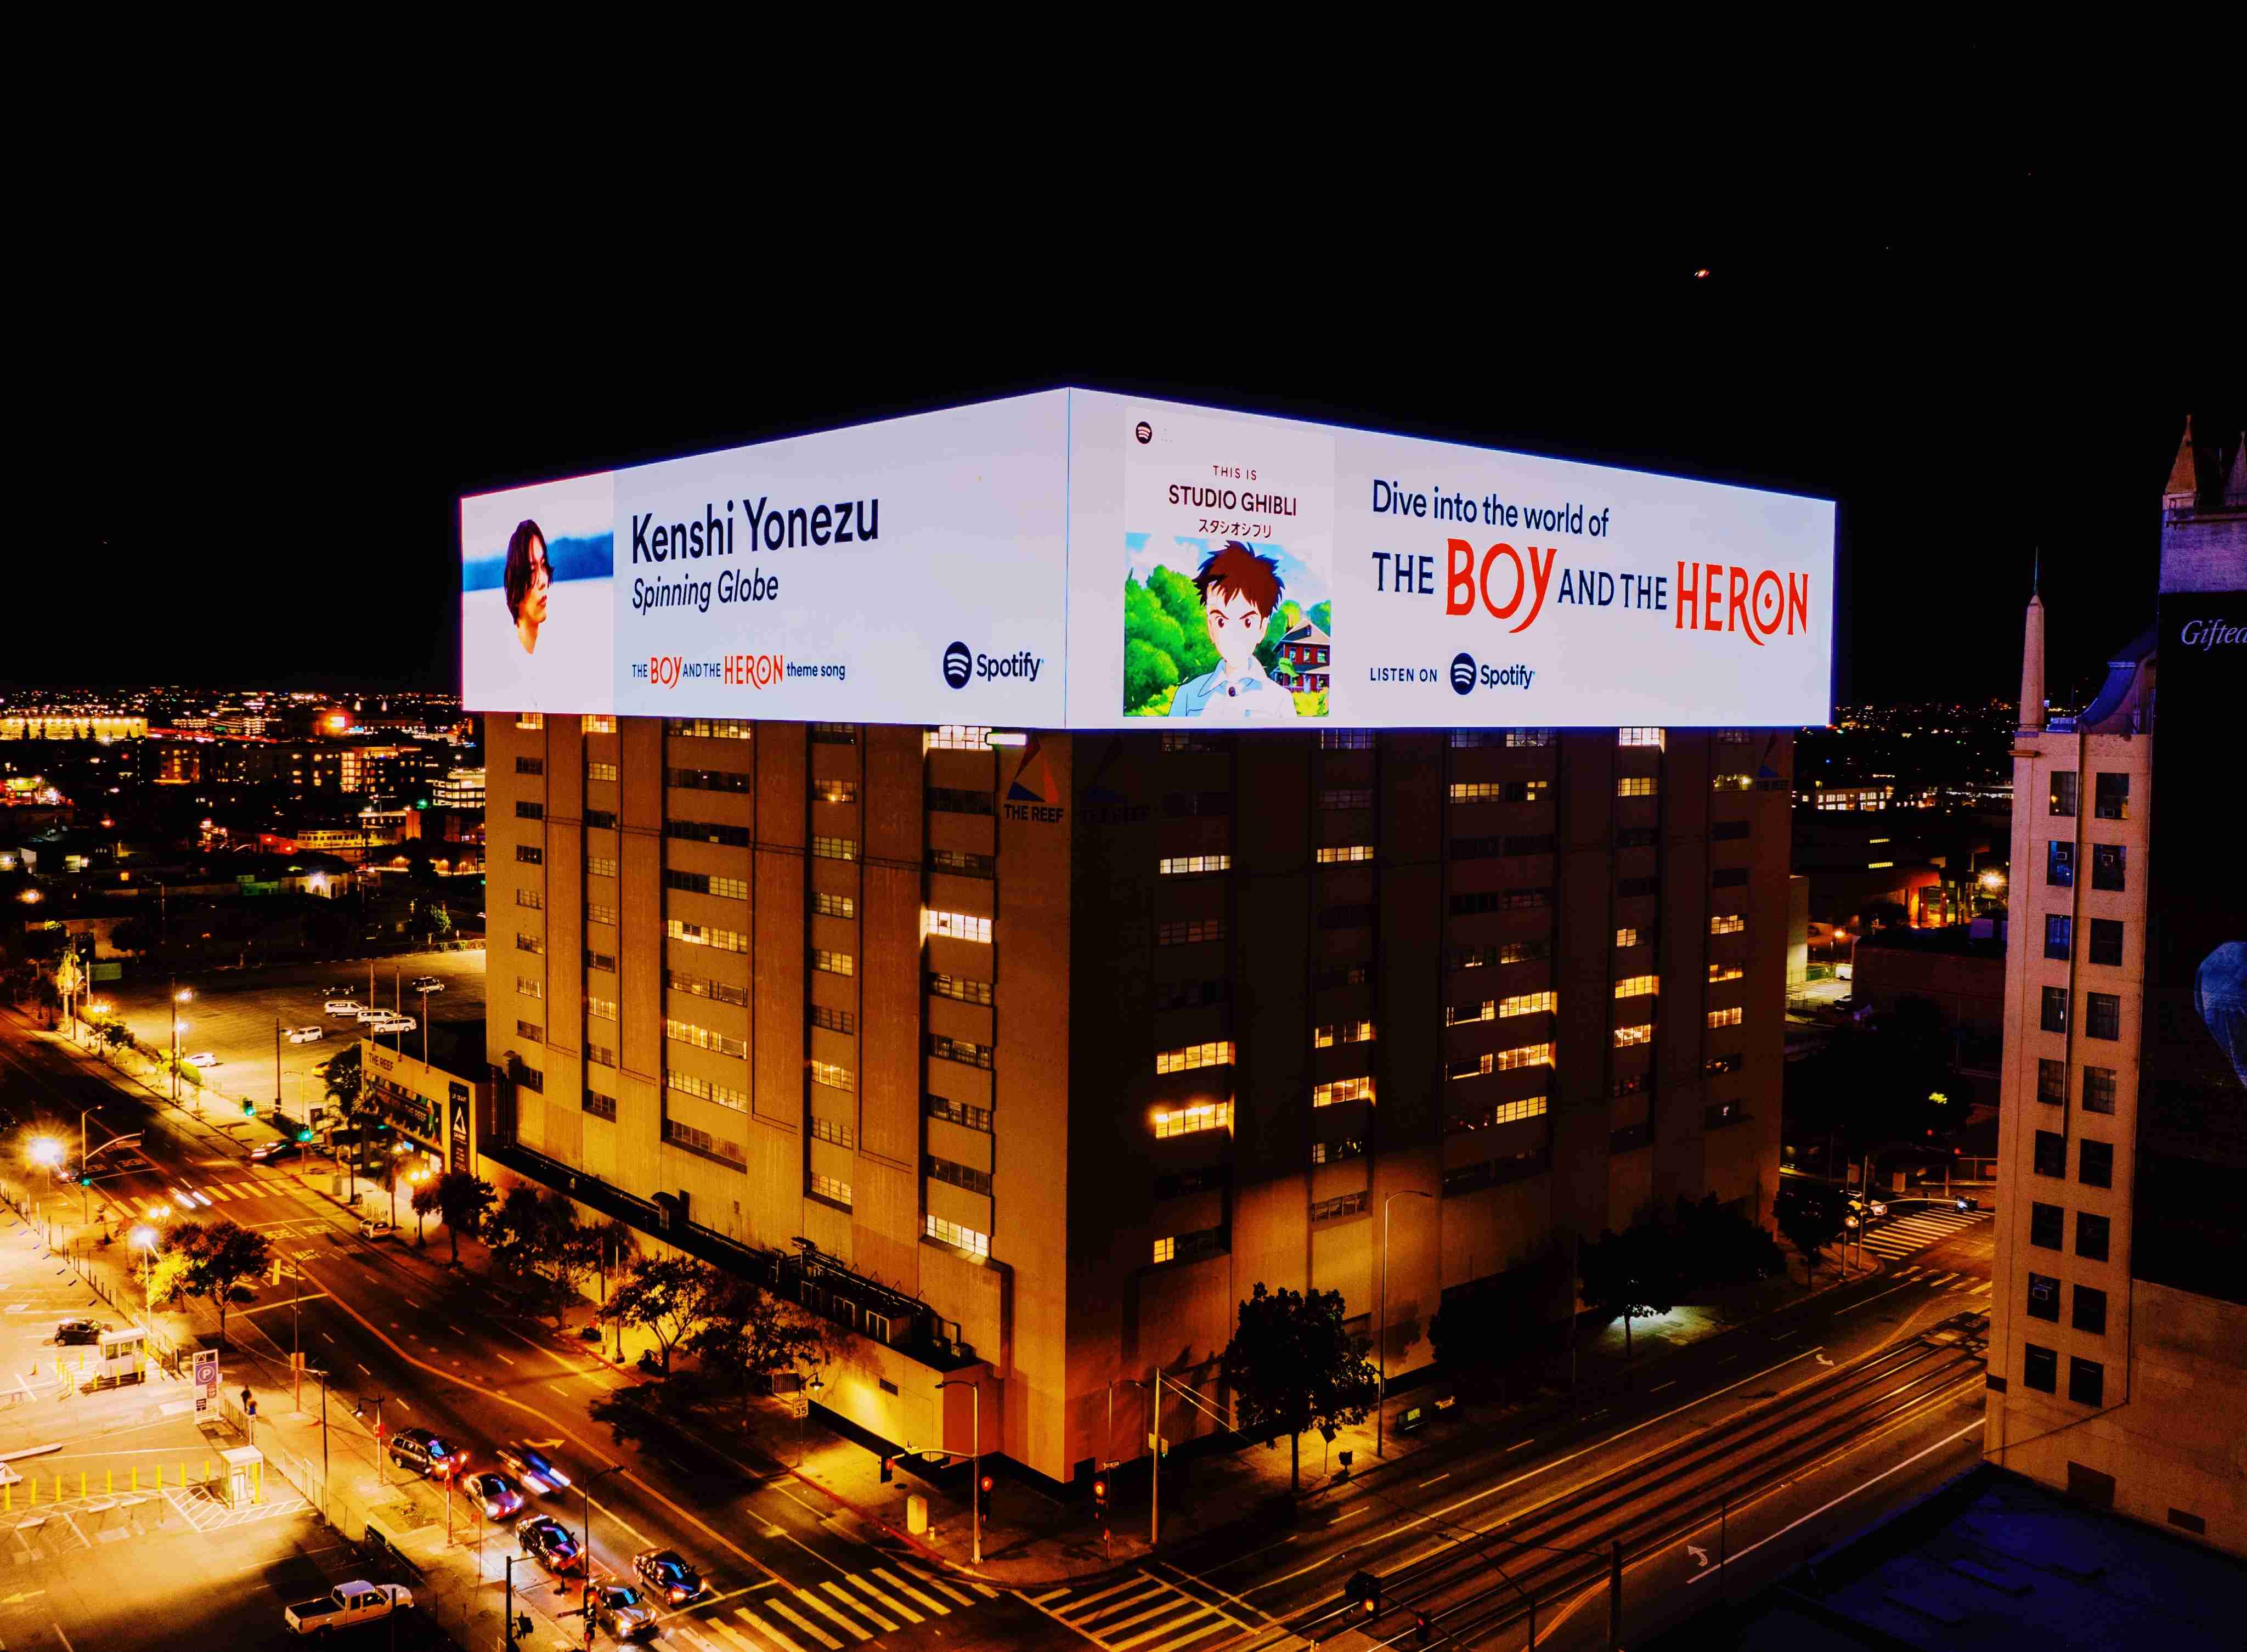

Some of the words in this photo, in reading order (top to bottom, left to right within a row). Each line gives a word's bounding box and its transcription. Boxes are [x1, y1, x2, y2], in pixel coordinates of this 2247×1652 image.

[1213, 465, 1240, 479] THIS
[1246, 469, 1256, 481] IS
[1168, 484, 1237, 510] STUDIO
[1241, 492, 1296, 516] GHIBLI
[1373, 479, 1427, 517] Dive
[1434, 486, 1477, 523] into
[1482, 493, 1518, 528] the
[1523, 503, 1583, 534] world
[1588, 508, 1609, 537] of
[633, 500, 734, 564] Kenshi
[743, 497, 878, 552] Yonezu
[632, 572, 712, 616] Spinning
[718, 567, 778, 604] Globe
[1371, 551, 1434, 595] THE
[1446, 538, 1557, 633] BOY
[1557, 568, 1614, 606] AND
[1620, 573, 1668, 610] THE
[1675, 561, 1809, 646] HERON
[632, 664, 648, 678] THE
[651, 657, 682, 689] BOY
[682, 663, 702, 677] AND
[703, 663, 721, 677] THE
[724, 655, 783, 690] HERON
[786, 661, 818, 677] theme
[821, 666, 845, 681] song
[976, 651, 1041, 682] Spotify
[1370, 667, 1414, 682] LISTEN
[1419, 669, 1437, 683] ON
[1480, 664, 1533, 690] Spotify
[1003, 804, 1028, 821] THE
[1031, 805, 1064, 823] REEF
[369, 1052, 379, 1066] THE
[379, 1057, 394, 1072] REEF
[202, 1368, 211, 1380] P
[795, 1407, 807, 1415] 35
